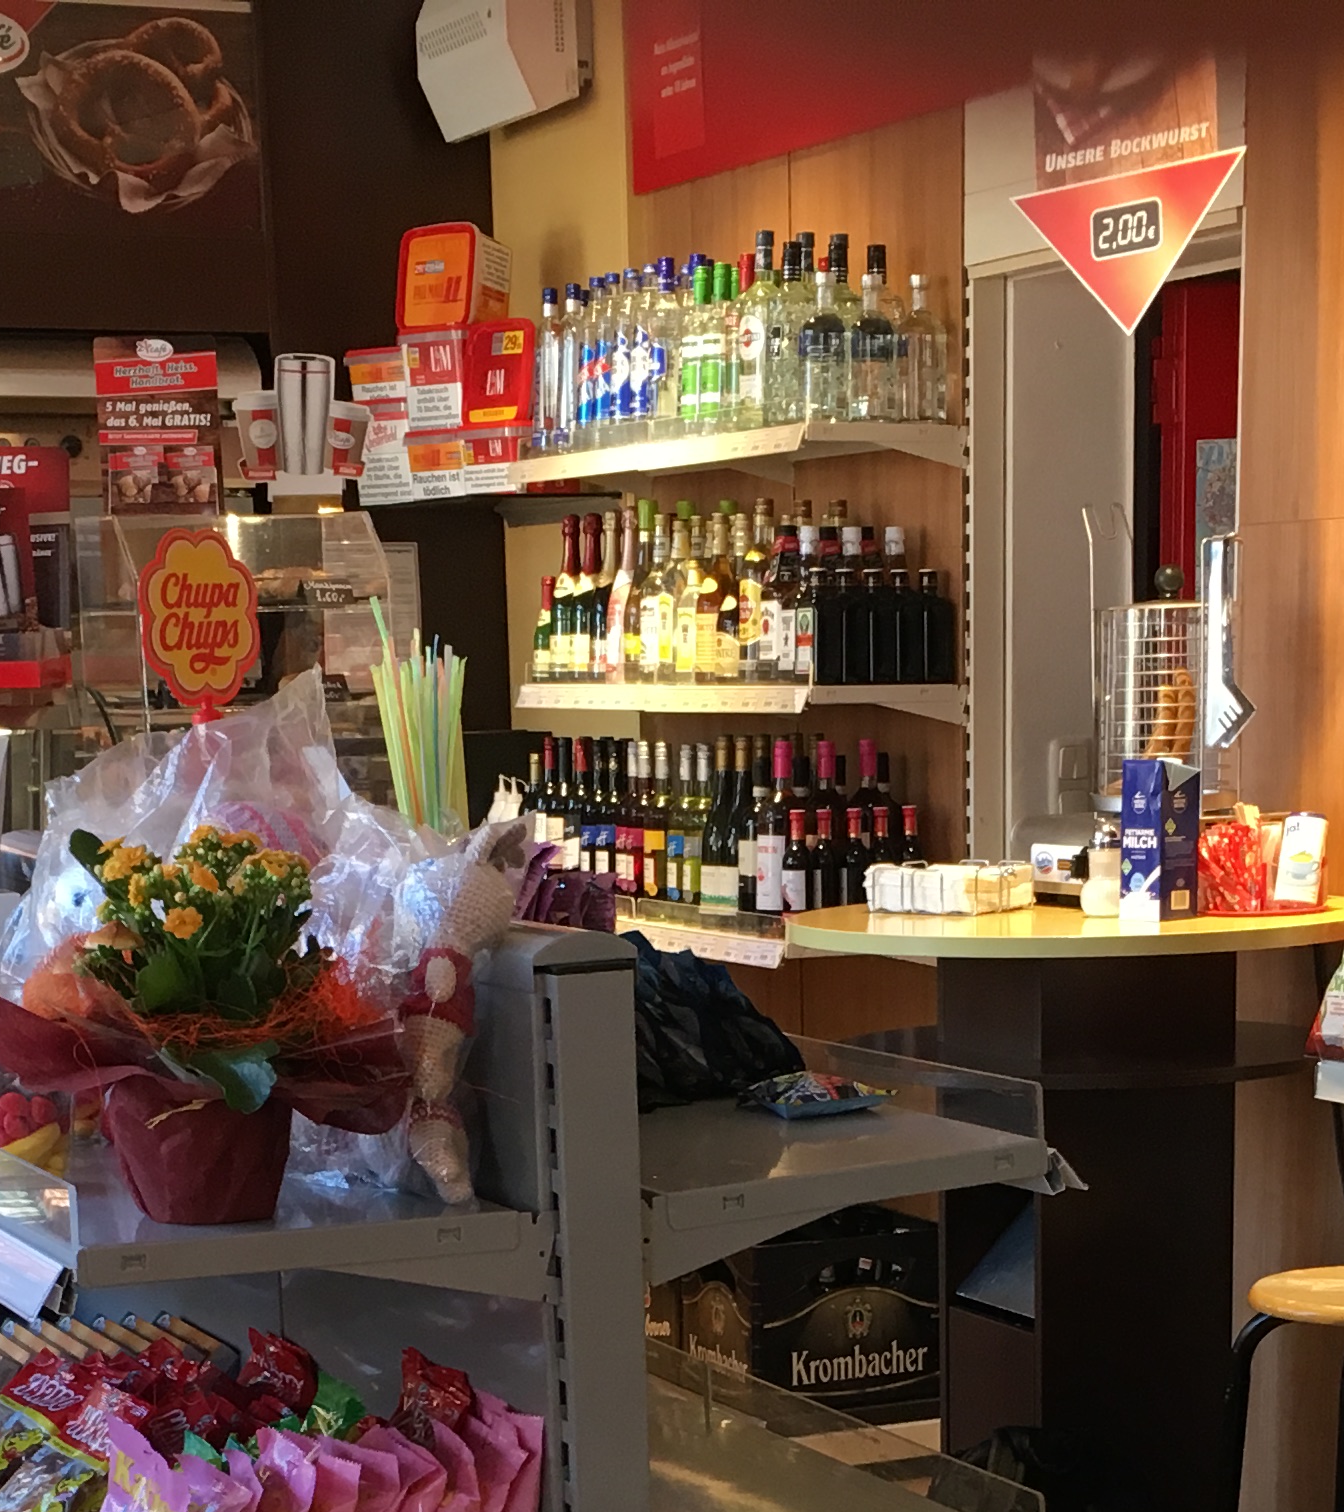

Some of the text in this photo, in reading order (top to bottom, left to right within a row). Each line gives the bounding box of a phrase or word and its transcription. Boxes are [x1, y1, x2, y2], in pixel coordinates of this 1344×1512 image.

[105, 401, 193, 414] 5 Mal genießen,
[106, 415, 127, 427] das
[142, 414, 162, 427] Mal
[165, 413, 211, 427] GRATIS!
[412, 473, 447, 485] Rauchen
[449, 472, 460, 482] ist
[422, 486, 451, 497] tödlich
[160, 572, 240, 619] Chupa
[159, 611, 239, 674] Chups
[1286, 822, 1300, 837] ja!
[1123, 836, 1157, 849] MILCH
[689, 1333, 749, 1384] Krombacher
[790, 1339, 928, 1387] Krombacher
